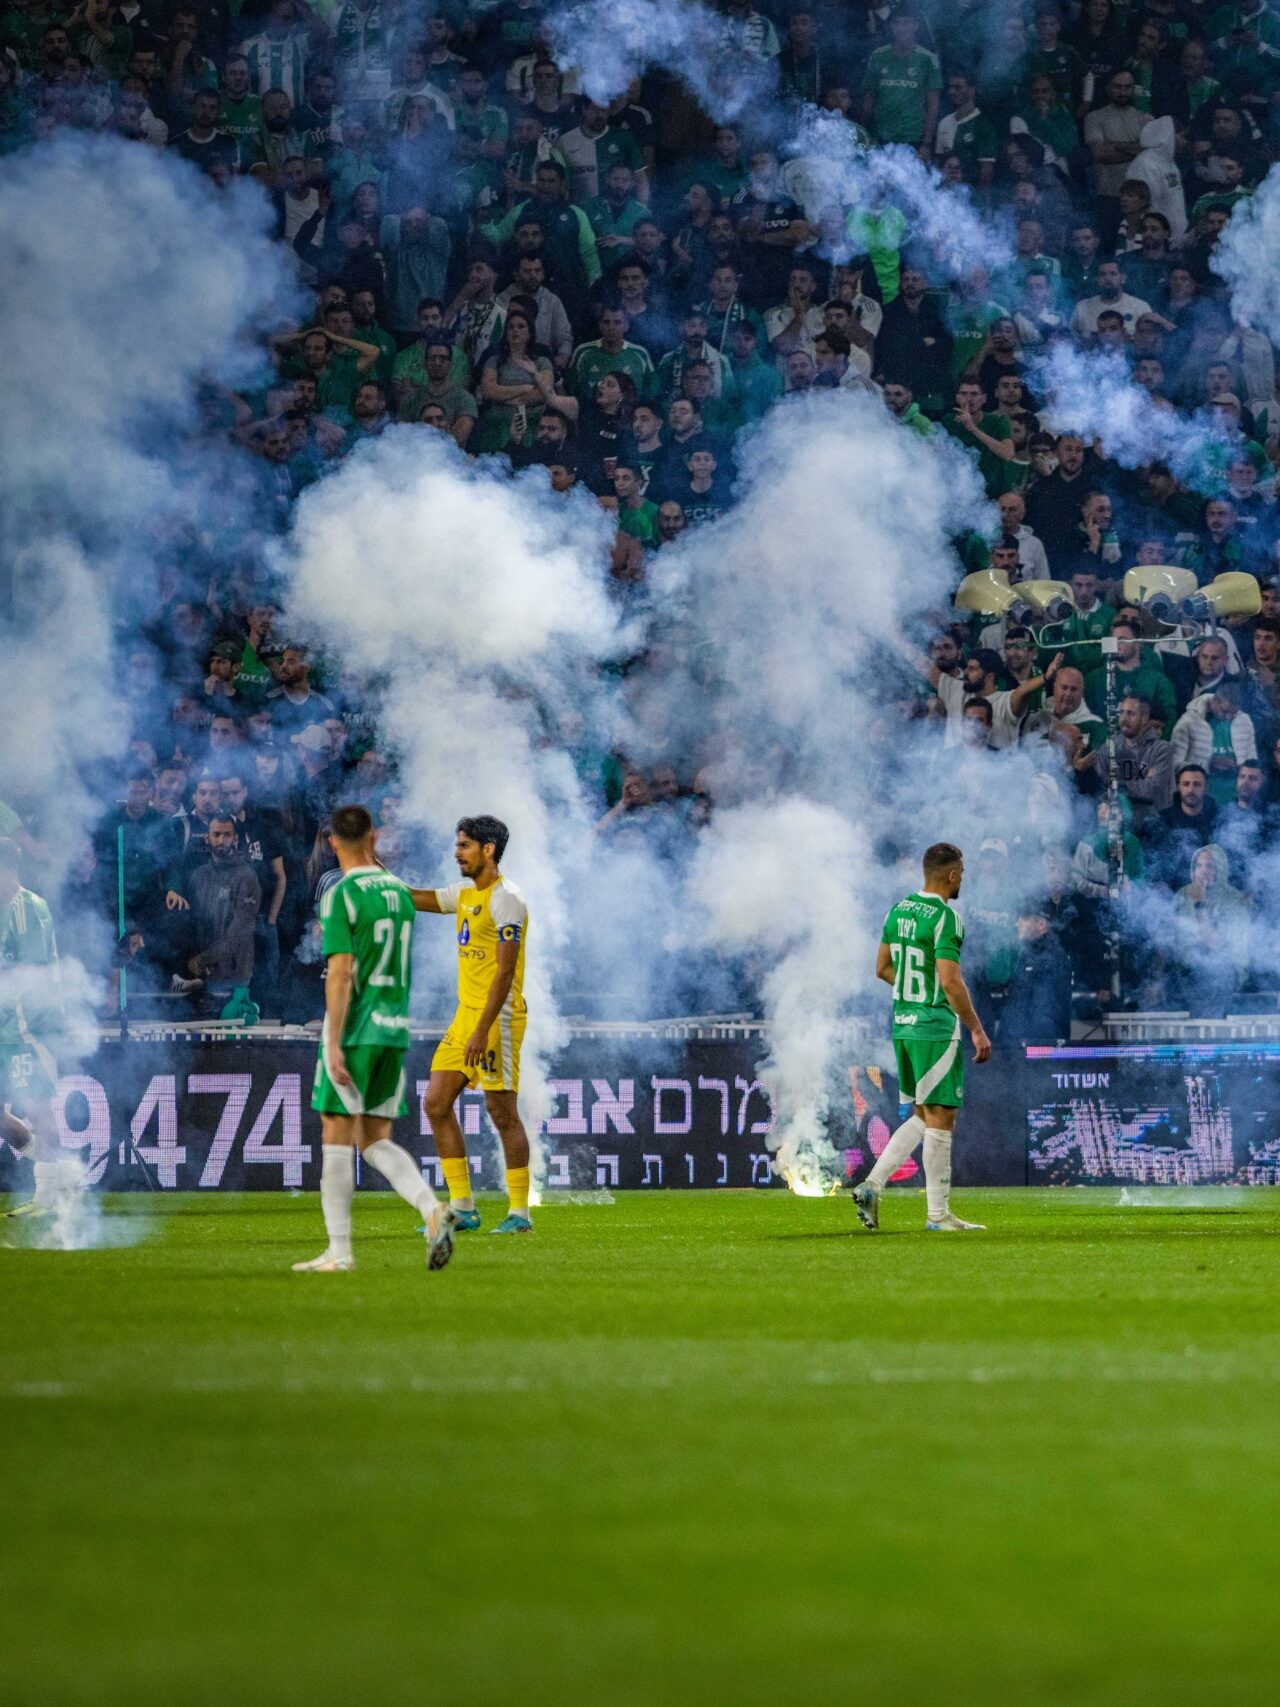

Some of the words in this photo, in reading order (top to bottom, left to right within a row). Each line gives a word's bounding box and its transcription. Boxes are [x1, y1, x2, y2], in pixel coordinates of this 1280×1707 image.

[368, 917, 412, 987] 21
[889, 942, 927, 1003] 26
[11, 1053, 33, 1077] 35
[1050, 1072, 1110, 1089] אשדוד
[650, 1074, 778, 1136] מרם
